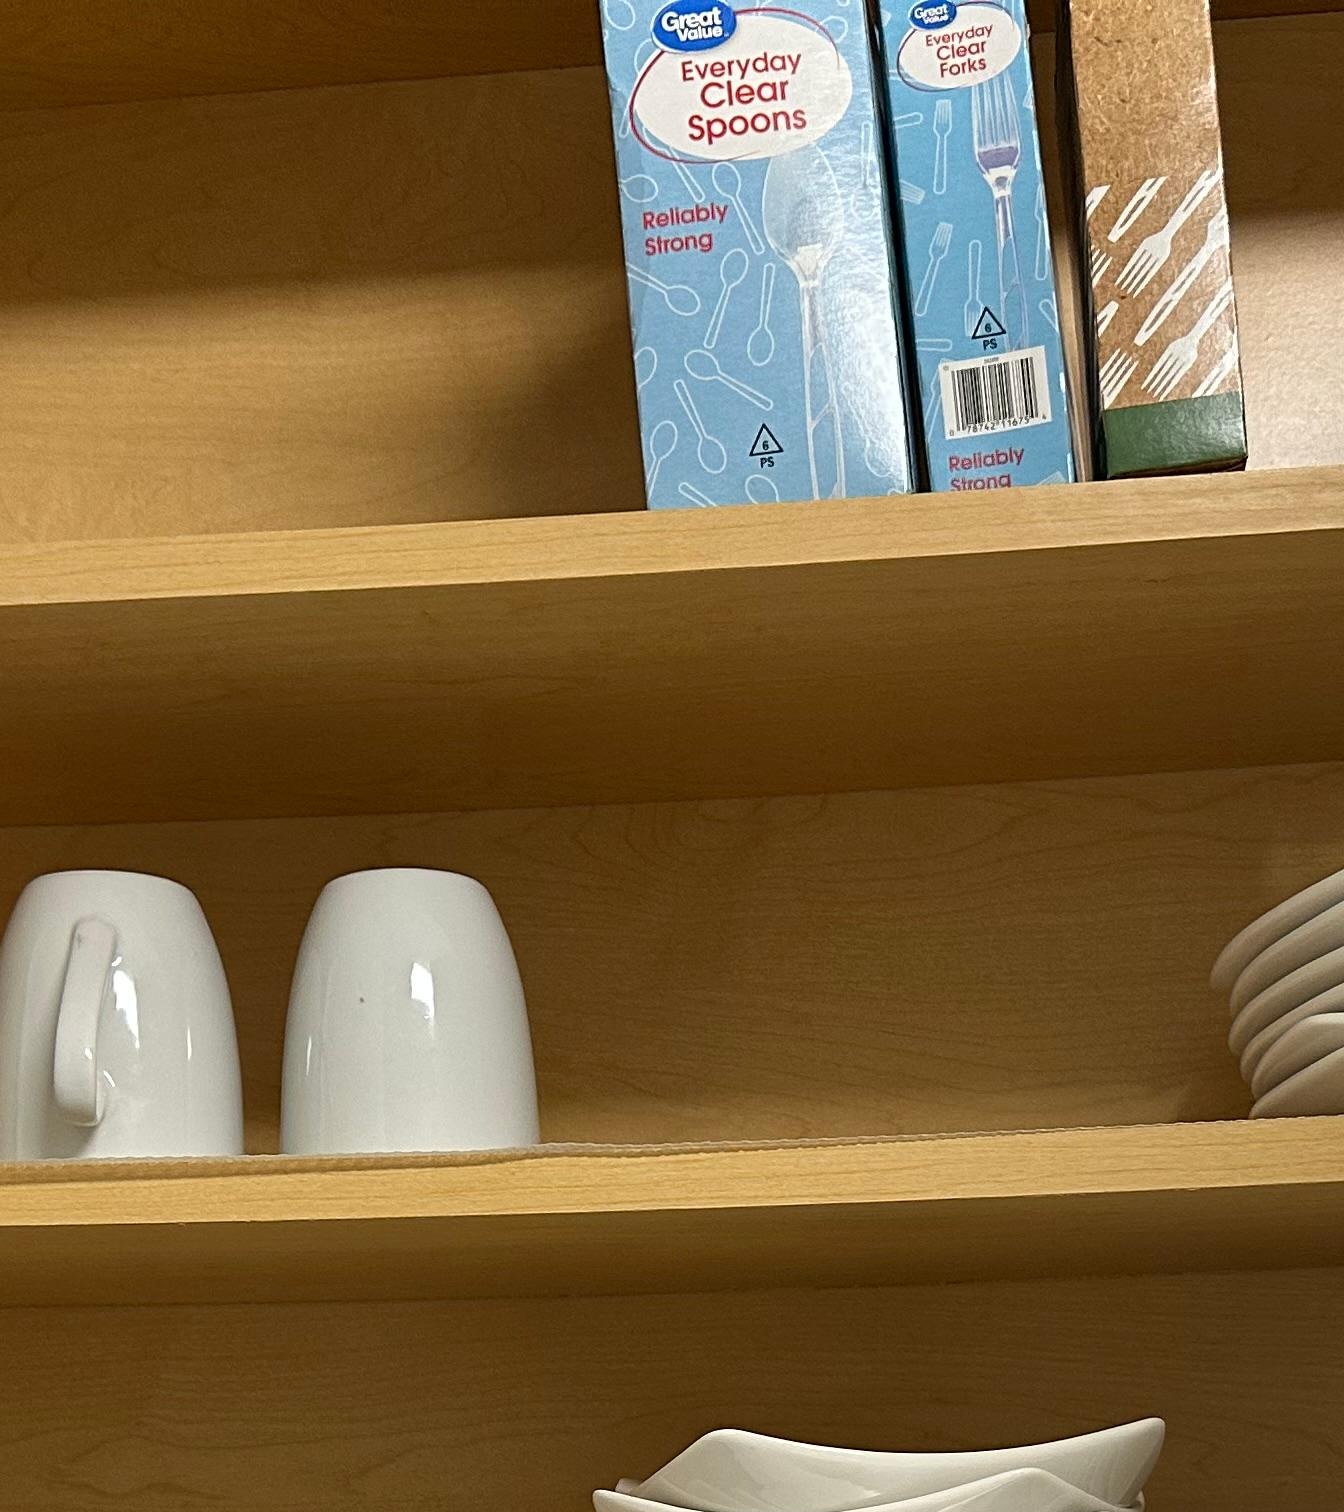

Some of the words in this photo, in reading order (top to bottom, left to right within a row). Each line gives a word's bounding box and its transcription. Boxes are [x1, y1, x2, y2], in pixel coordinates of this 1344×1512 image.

[661, 6, 722, 31] Great
[914, 4, 947, 19] Great
[676, 25, 723, 42] Value
[925, 24, 993, 46] Everyday
[936, 40, 987, 60] Clear
[681, 52, 801, 82] Everyday
[940, 58, 987, 78] Forks
[700, 79, 789, 108] Clear
[688, 109, 807, 145] Spoons
[642, 202, 728, 230] Reliably
[645, 233, 713, 256] Strong
[985, 323, 992, 332] 6
[983, 338, 997, 351] PS
[762, 440, 769, 450] 6
[760, 456, 774, 468] PS
[949, 447, 1024, 472] Reliably
